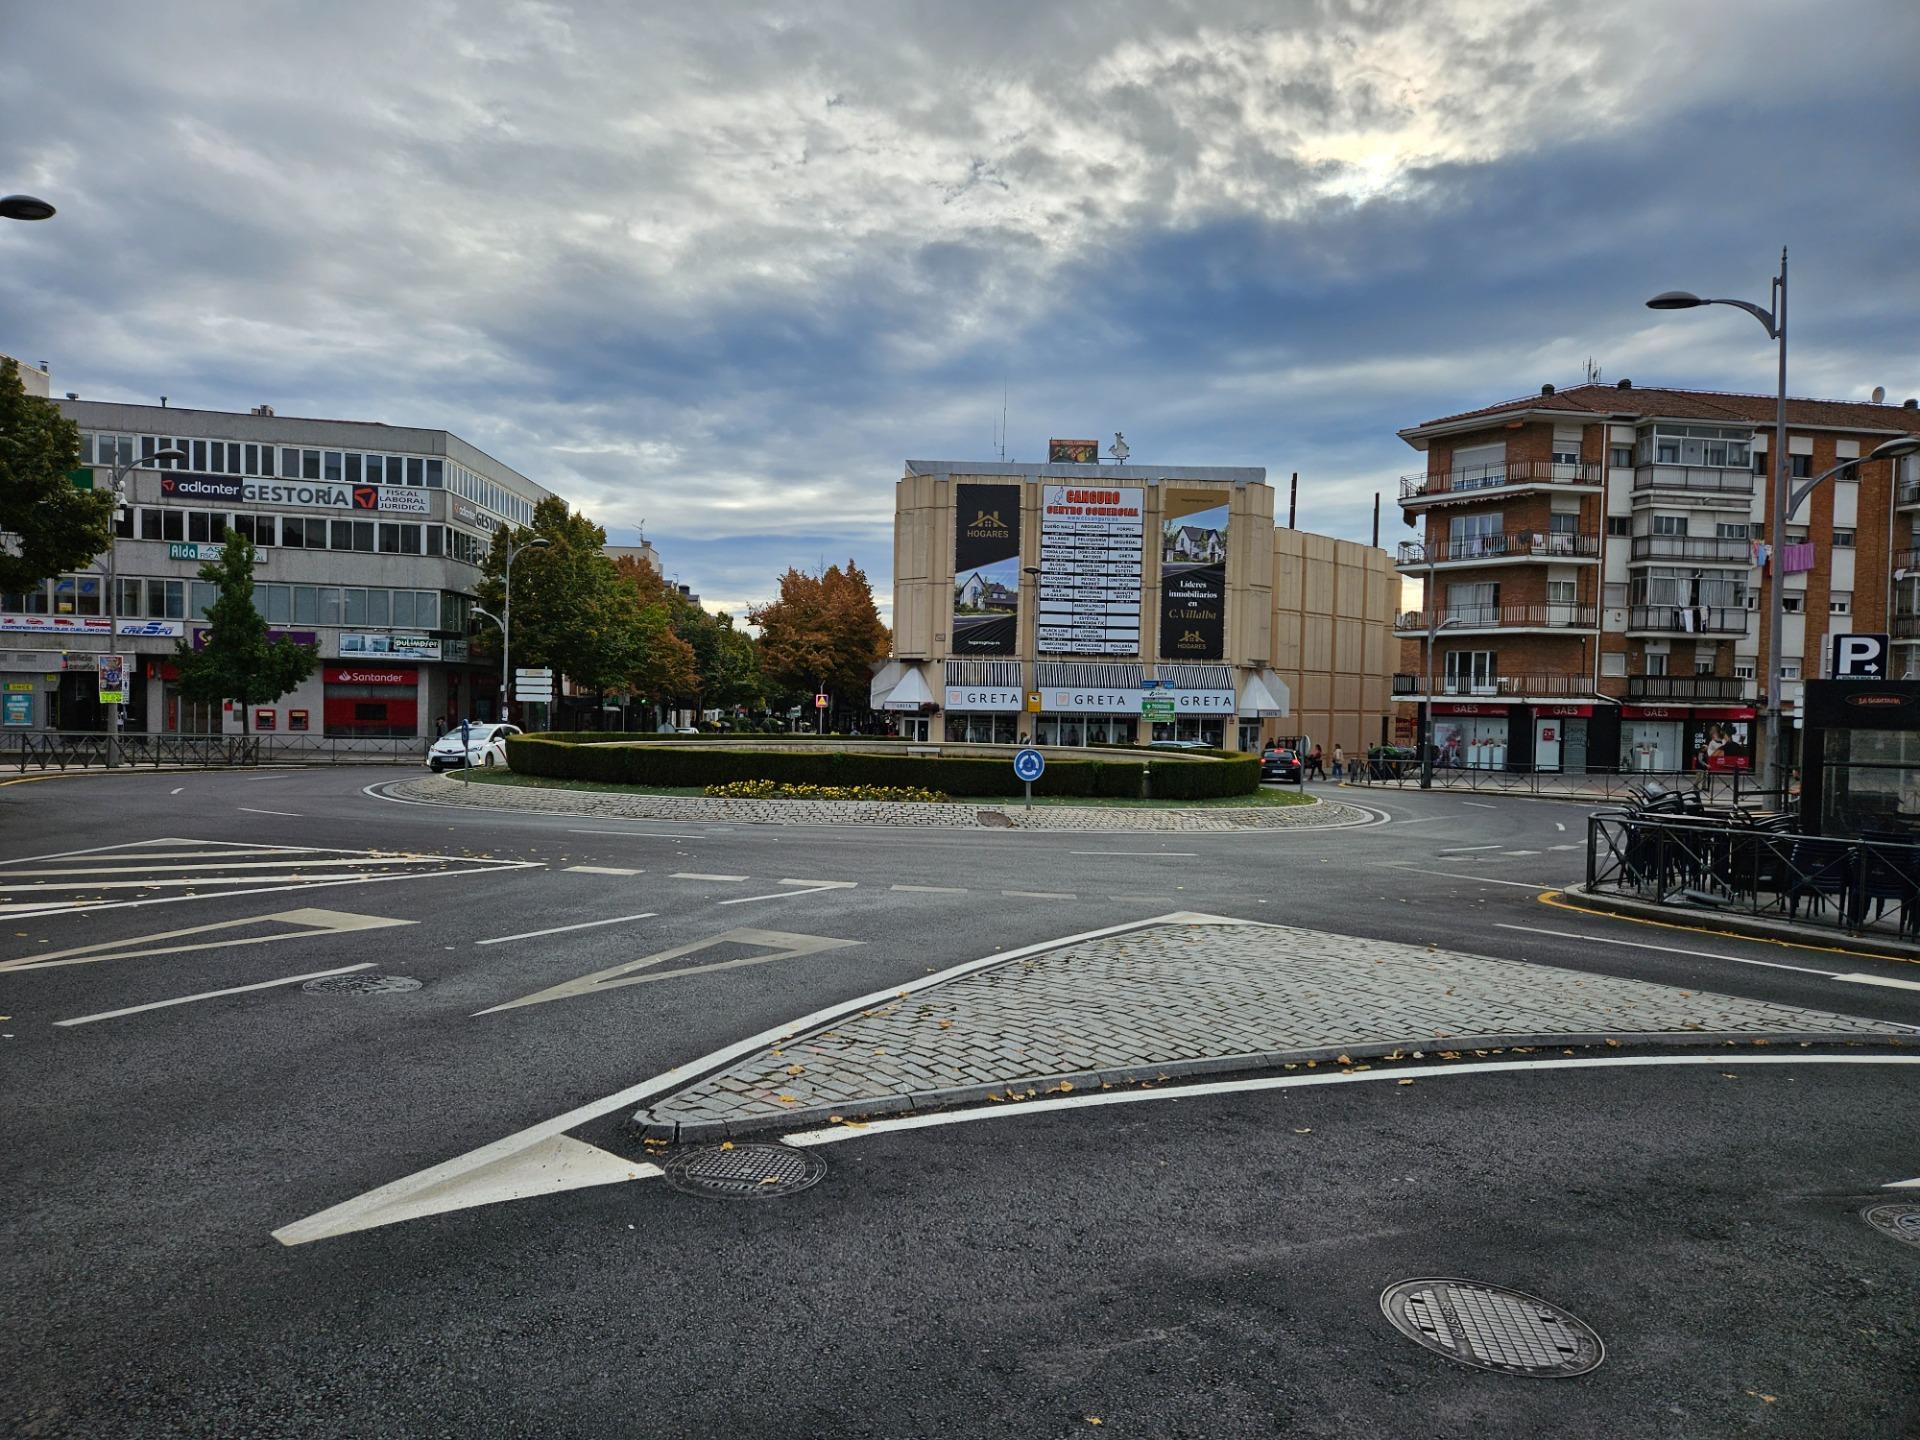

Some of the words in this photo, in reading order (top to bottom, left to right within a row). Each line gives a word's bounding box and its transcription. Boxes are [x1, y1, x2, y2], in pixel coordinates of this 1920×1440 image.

[178, 480, 239, 495] adlanter
[242, 480, 350, 506] GESTORÍA
[386, 489, 418, 497] FISCAL
[1066, 489, 1120, 504] CANGURO
[380, 496, 426, 504] LABORAL
[1046, 505, 1083, 515] CENTRO
[1085, 506, 1139, 517] COMERCIAL
[967, 530, 1009, 538] HOGARES
[171, 544, 196, 558] Alda
[1168, 590, 1218, 598] inmobiliarios
[1838, 637, 1880, 674] P
[352, 672, 403, 682] Santander
[967, 693, 1018, 704] GRETA
[1074, 694, 1126, 705] GRETA
[1180, 696, 1232, 706] GRETA
[1453, 705, 1479, 713] GAES
[1552, 706, 1578, 714] GAES
[1644, 708, 1668, 716] GAES
